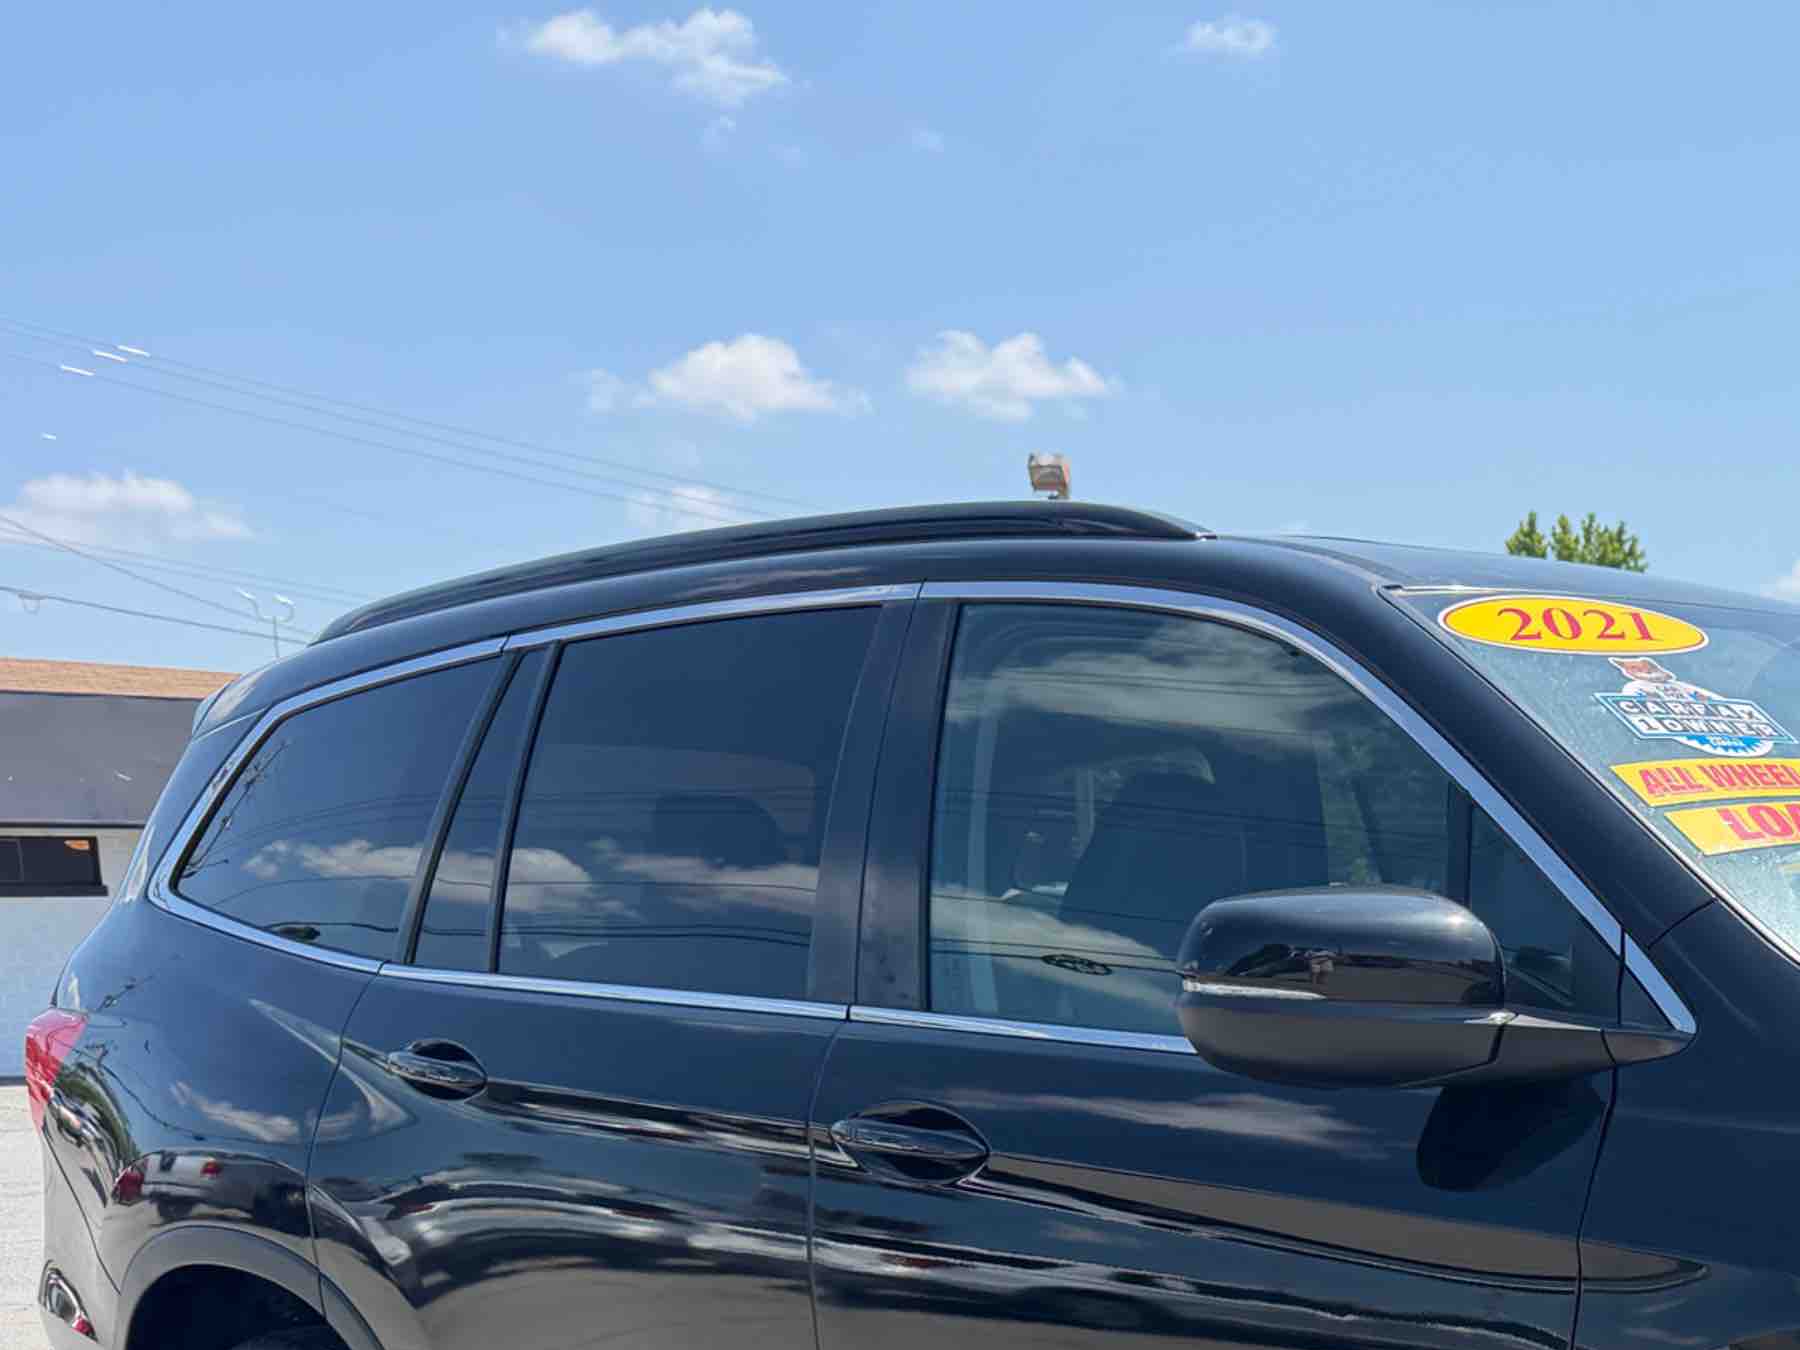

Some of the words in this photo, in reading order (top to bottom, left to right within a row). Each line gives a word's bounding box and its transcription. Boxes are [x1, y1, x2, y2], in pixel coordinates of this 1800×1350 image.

[1497, 606, 1664, 641] 2021
[1617, 698, 1764, 721] CARFAX
[1662, 718, 1778, 737] OWNER
[1638, 766, 1710, 797] ALL
